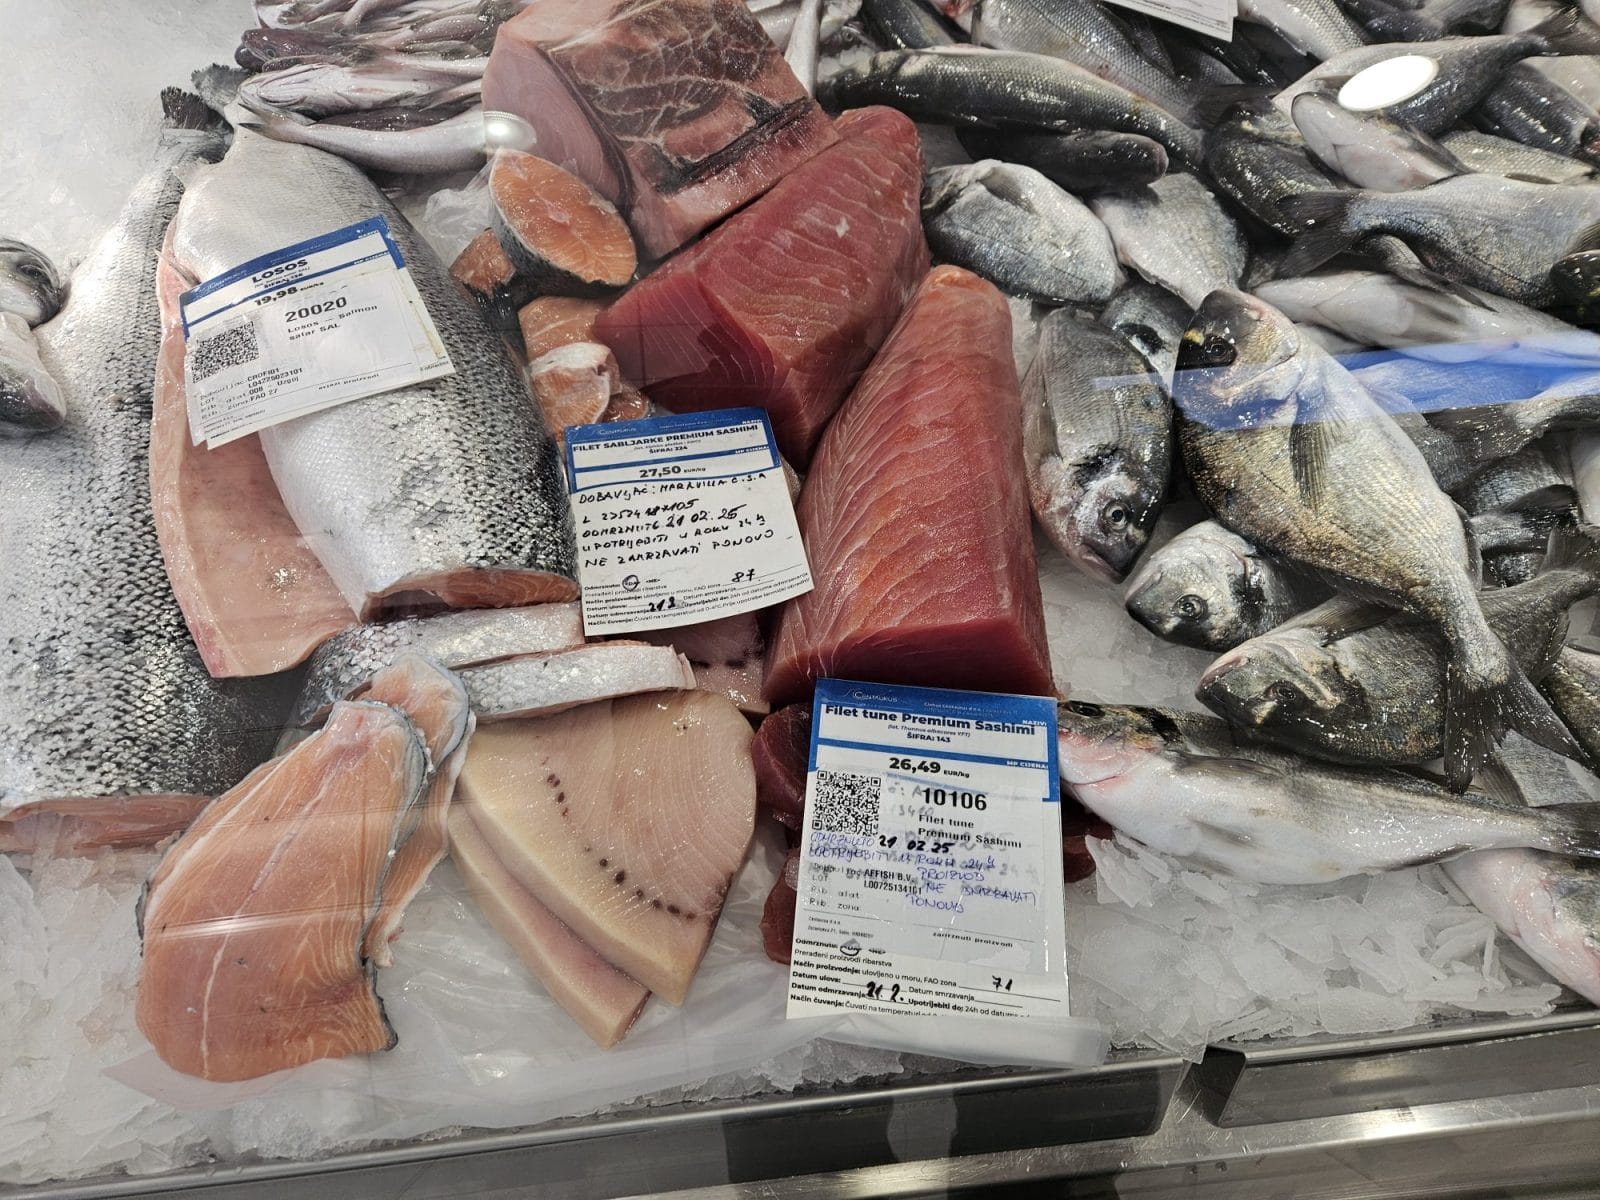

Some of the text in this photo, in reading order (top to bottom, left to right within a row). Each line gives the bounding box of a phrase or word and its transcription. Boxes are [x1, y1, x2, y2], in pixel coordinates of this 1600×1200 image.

[252, 259, 308, 283] LOSOS
[254, 286, 298, 305] 19,98
[284, 297, 348, 323] 20020
[287, 321, 319, 333] Losos
[339, 305, 378, 320] Salmon
[319, 323, 340, 333] SAL
[573, 443, 601, 452] FILET
[603, 435, 664, 448] SABLJARKE
[666, 430, 714, 441] PREMIUM
[716, 424, 758, 436] SASHIMI
[640, 465, 681, 479] 27,50
[584, 557, 608, 569] NE
[825, 704, 859, 718] Filet
[861, 707, 897, 722] tune
[902, 713, 970, 729] Premium
[975, 720, 1035, 735] Sashimi
[906, 732, 951, 744] ŠIFRA: 143
[889, 757, 970, 779] 26,49 EUR/kg
[922, 787, 987, 811] 10106
[919, 814, 974, 829] Filet tune
[918, 827, 971, 842] Premium
[975, 834, 1022, 848] Sashimi
[864, 869, 895, 879] AFFISH
[795, 949, 828, 960] Prerađeni
[863, 958, 892, 968] ribarstva
[792, 971, 817, 981] Datum
[793, 959, 815, 969] Način
[816, 963, 861, 975] proizvodnje:
[862, 969, 893, 981] ulovljeno
[924, 977, 939, 985] FAO
[940, 980, 957, 988] zona
[791, 982, 817, 991] Datum
[908, 986, 975, 1002] Datum smrzavanja
[790, 994, 812, 1003] Način
[845, 1000, 868, 1011] Čuvati
[908, 998, 950, 1011] Upotrijebiti
